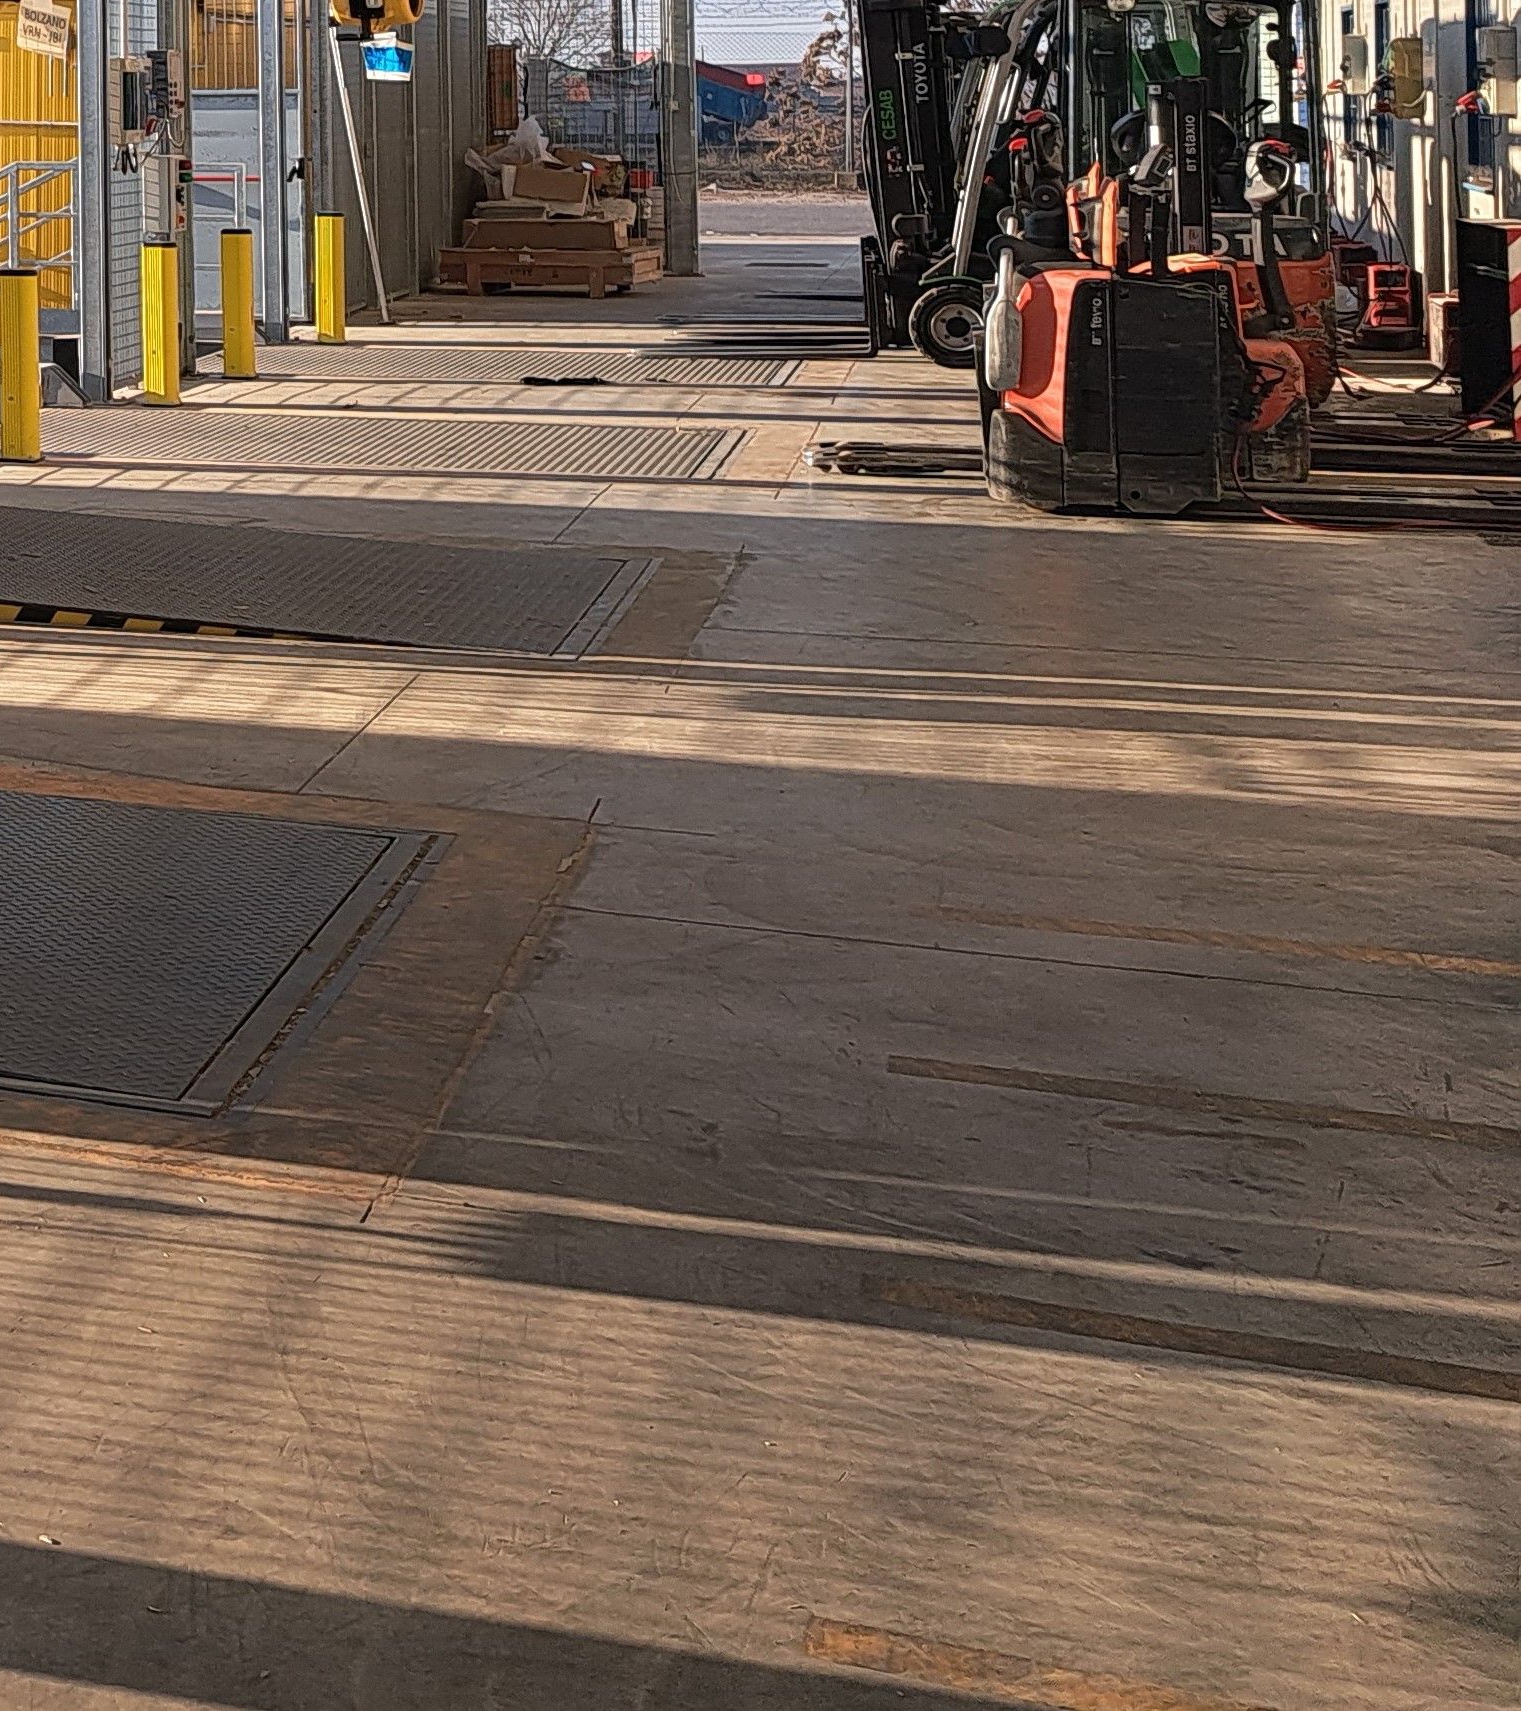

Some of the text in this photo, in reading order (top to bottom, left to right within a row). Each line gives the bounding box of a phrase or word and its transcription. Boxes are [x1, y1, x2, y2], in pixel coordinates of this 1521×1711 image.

[24, 7, 67, 30] BOLZANO
[912, 41, 930, 104] TOYOTA
[878, 89, 897, 141] CESAB
